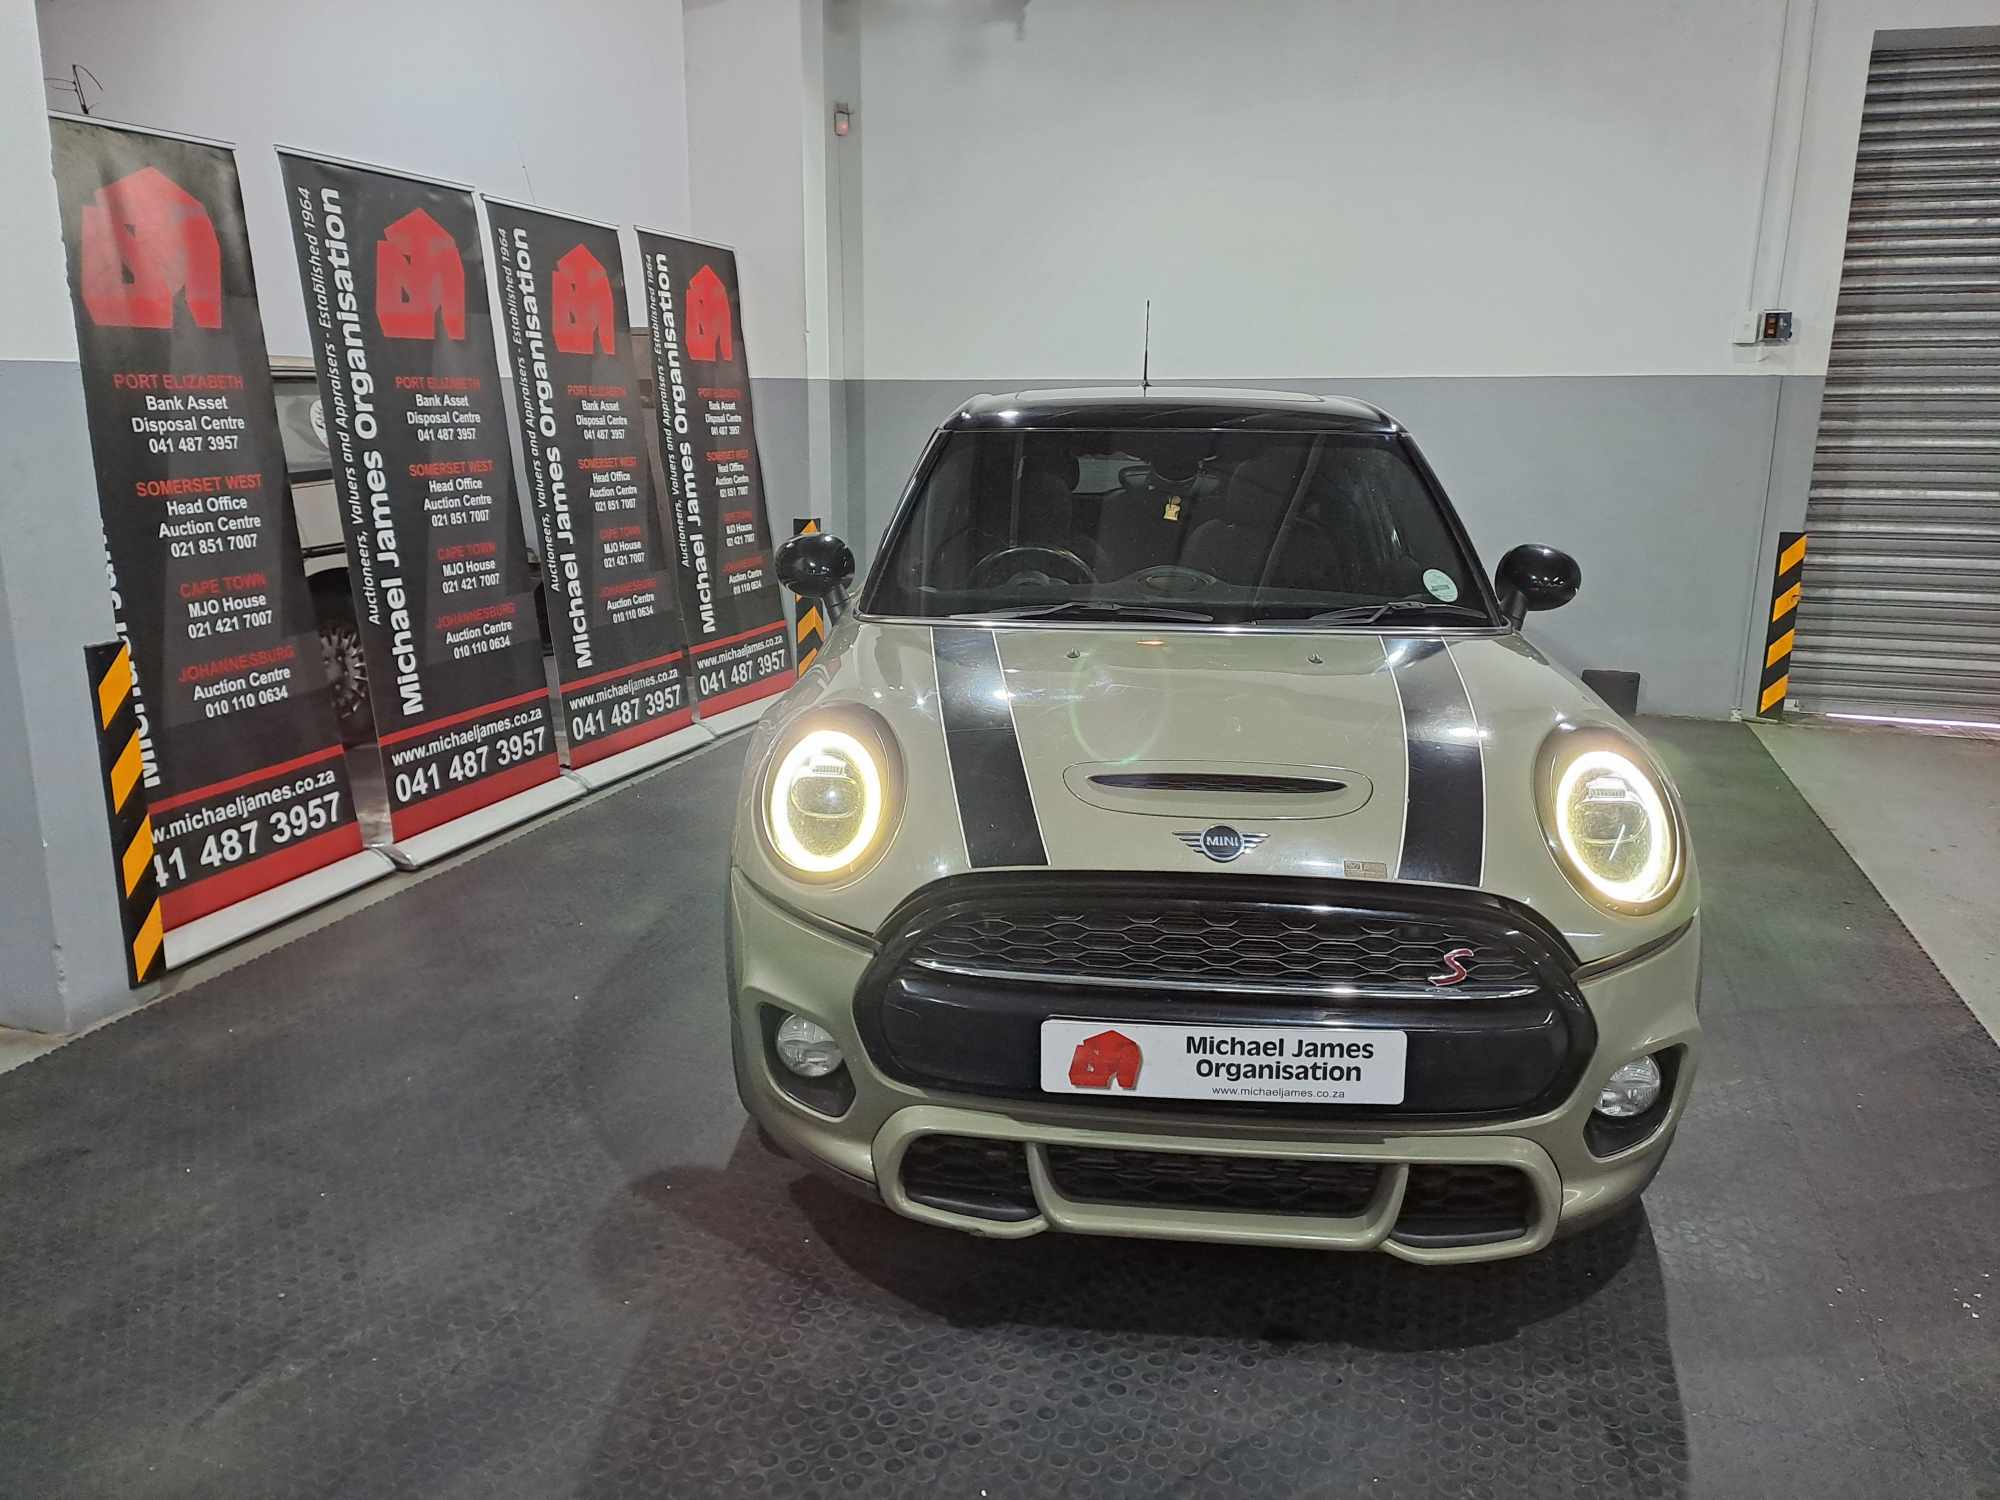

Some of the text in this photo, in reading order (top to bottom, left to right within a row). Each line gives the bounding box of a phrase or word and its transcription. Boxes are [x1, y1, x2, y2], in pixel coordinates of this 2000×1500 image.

[112, 373, 162, 389] PORT
[145, 395, 228, 410] Bank Asset
[297, 186, 380, 624] Auctioneers, Valuers and Appraisers Established 1964
[415, 393, 469, 406] Bank Asset
[657, 364, 671, 426] Appraisers
[406, 410, 480, 426] Disposal Centre
[497, 227, 559, 591] Auctioneers, Valuers and Appraisers Established 1964
[131, 415, 244, 435] Disposal Centre
[417, 427, 475, 441] 041 487 3957
[148, 435, 237, 453] 041 487 3957
[513, 228, 592, 668] Michael James Organisation
[655, 253, 715, 633] Michael James Organisation
[663, 427, 673, 450] and
[320, 188, 423, 715] Michael James Organisation
[137, 473, 260, 496] SOMERSET WEST
[428, 477, 482, 492] Head Office
[668, 453, 679, 494] Valuers
[166, 495, 247, 515] Head Office
[423, 493, 492, 510] Auction Centre
[159, 515, 261, 537] Auction Centre
[431, 509, 489, 526] 021 851 7007
[170, 533, 257, 557] 021 851 7007
[442, 559, 495, 576] MJO House
[180, 572, 266, 597] CAPE TOWN
[442, 572, 499, 593] 021 421 7007
[188, 594, 266, 617] MJO House
[187, 609, 272, 638] 021 421 7007
[446, 621, 512, 644] Auction Centre
[453, 634, 510, 658] 010 110 0634
[699, 648, 784, 695] 041 487 3957
[193, 668, 290, 700] Auction Centre
[569, 668, 678, 710] www.michaeljames.co.za
[205, 684, 288, 717] 010 110 0634
[572, 684, 680, 740] 041 487 3957
[391, 708, 542, 766] www.michaeljames.co.za
[395, 725, 544, 801] 041 487 3957
[200, 820, 258, 866] 487
[269, 791, 339, 842] 3957
[1206, 836, 1239, 847] MINI
[1428, 948, 1474, 986] S
[1186, 1036, 1374, 1059] Michael James
[1196, 1059, 1361, 1081] Organisation
[1212, 1086, 1345, 1099] www.michaeljames.co.za
